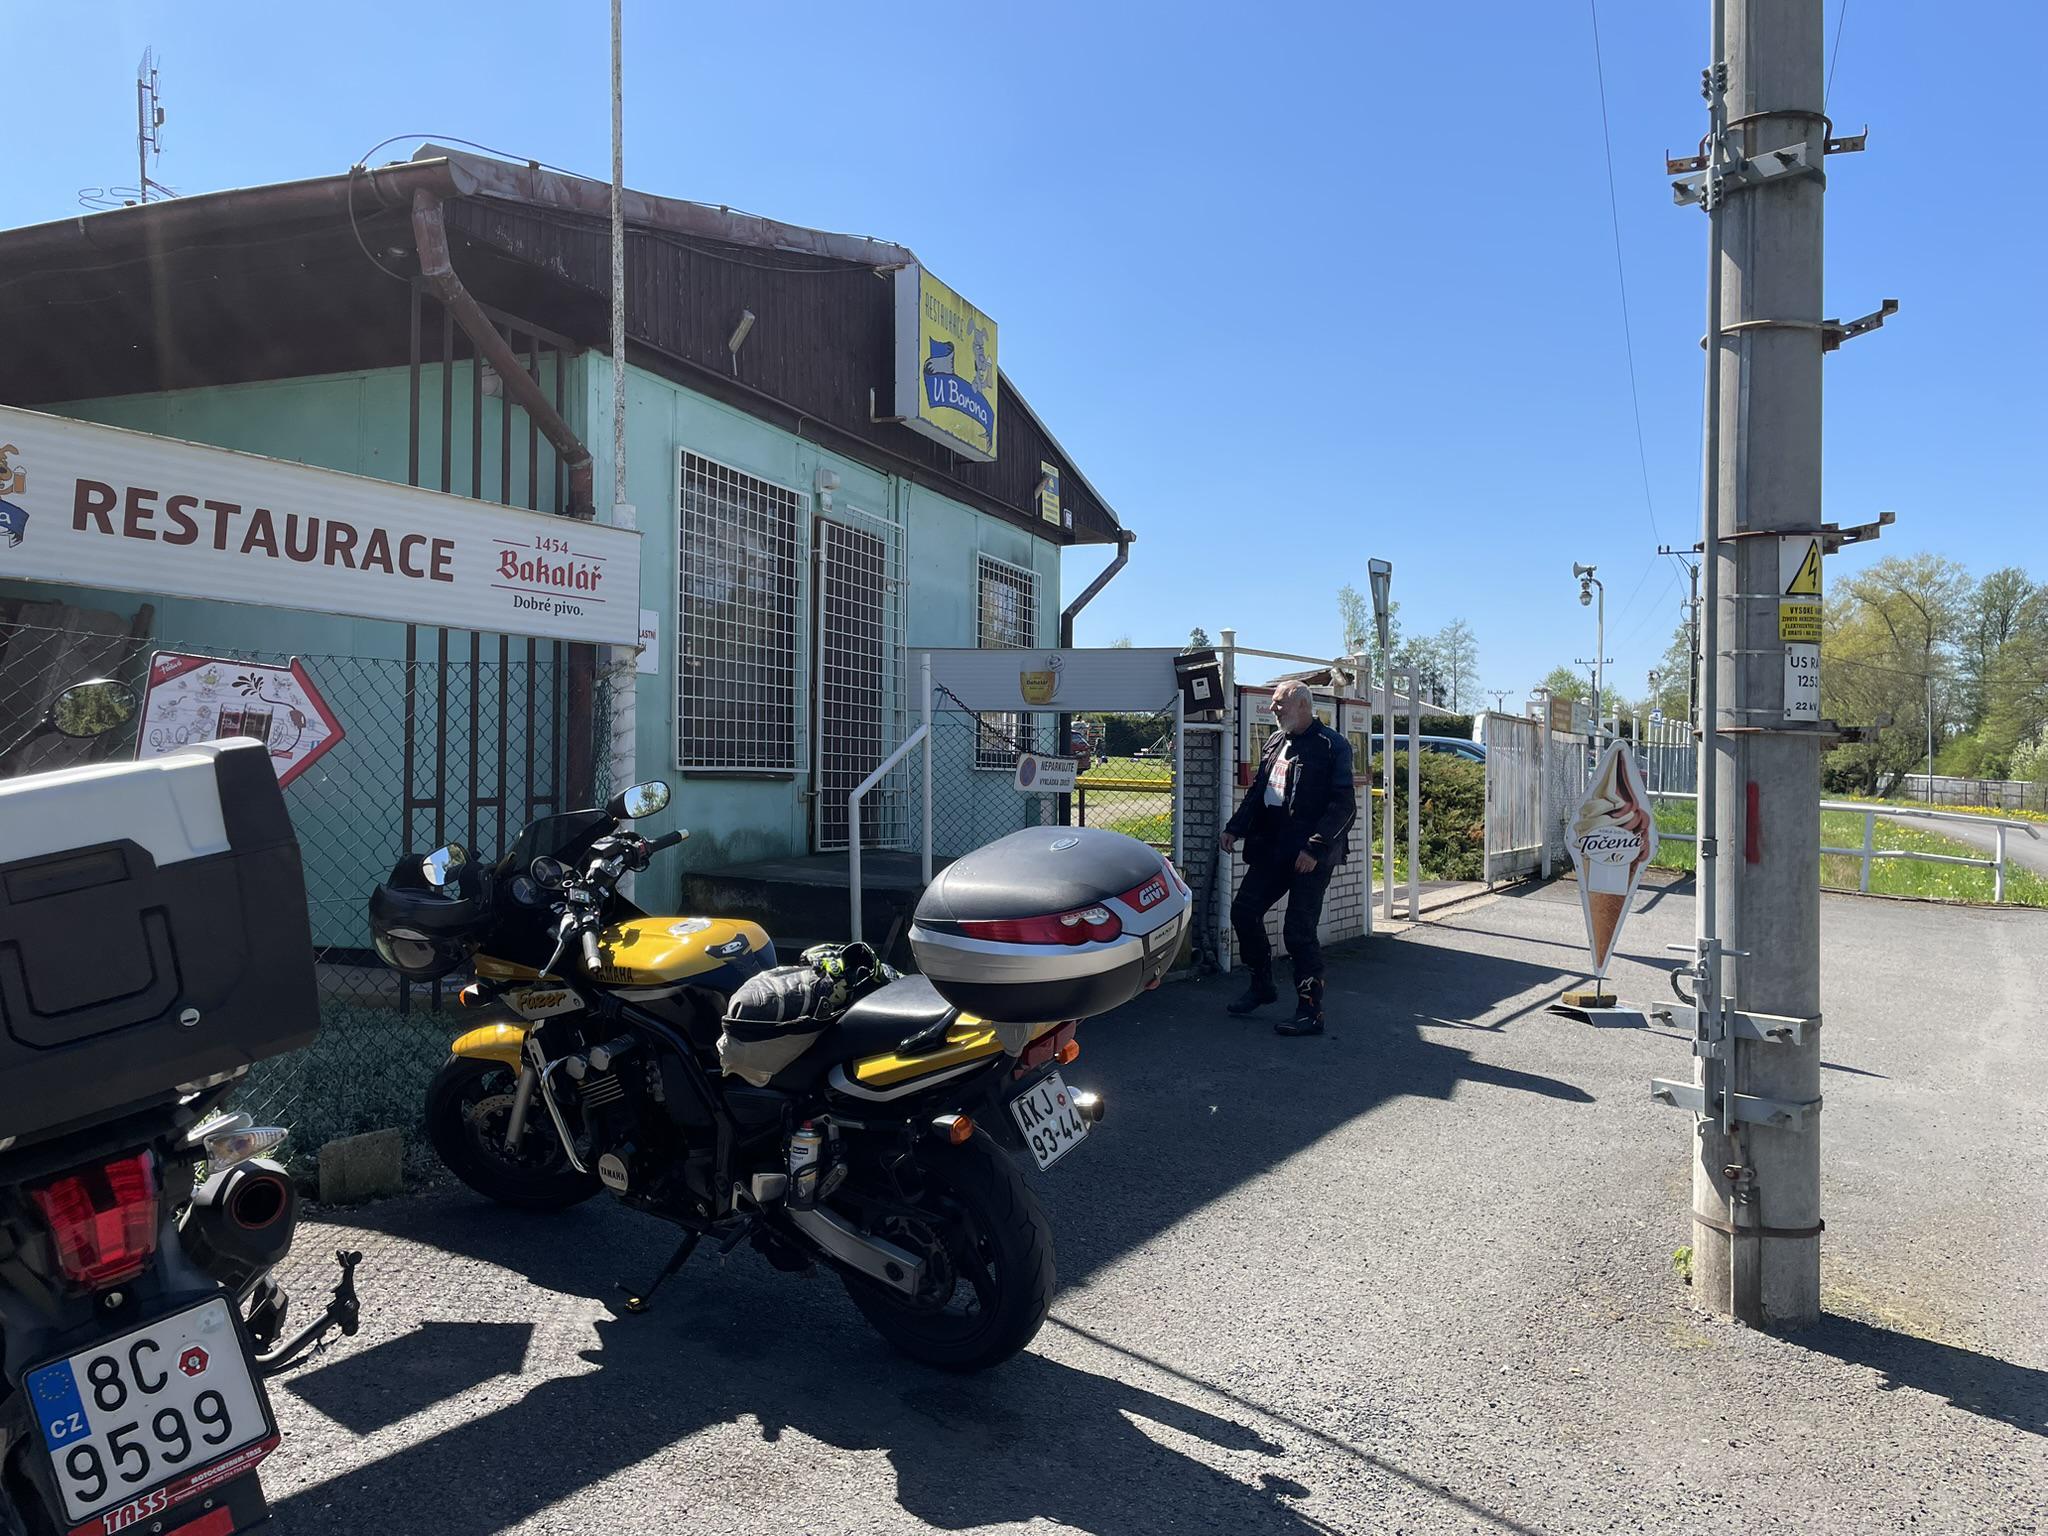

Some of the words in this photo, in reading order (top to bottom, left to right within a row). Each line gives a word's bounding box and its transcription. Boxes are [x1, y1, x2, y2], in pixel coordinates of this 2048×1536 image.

[925, 292, 964, 341] RESTAURACE
[934, 377, 945, 403] U
[948, 379, 988, 424] Barona
[72, 478, 455, 583] RESTAURACE
[535, 536, 569, 554] 1454
[496, 550, 602, 591] Bakalář
[513, 595, 551, 612] Dobré
[554, 601, 584, 616] pivo.
[1791, 656, 1807, 668] US
[1796, 702, 1807, 710] 22
[1579, 833, 1641, 853] Točená
[1140, 882, 1165, 906] GIVI
[517, 991, 567, 1012] Fazer
[1018, 1089, 1053, 1131] AKJ
[1033, 1109, 1082, 1160] 93-44
[600, 1167, 625, 1182] YAMAHA
[87, 1339, 168, 1412] 8C
[50, 1412, 83, 1439] CZ
[66, 1390, 232, 1502] 9599
[103, 1487, 168, 1535] TASS
